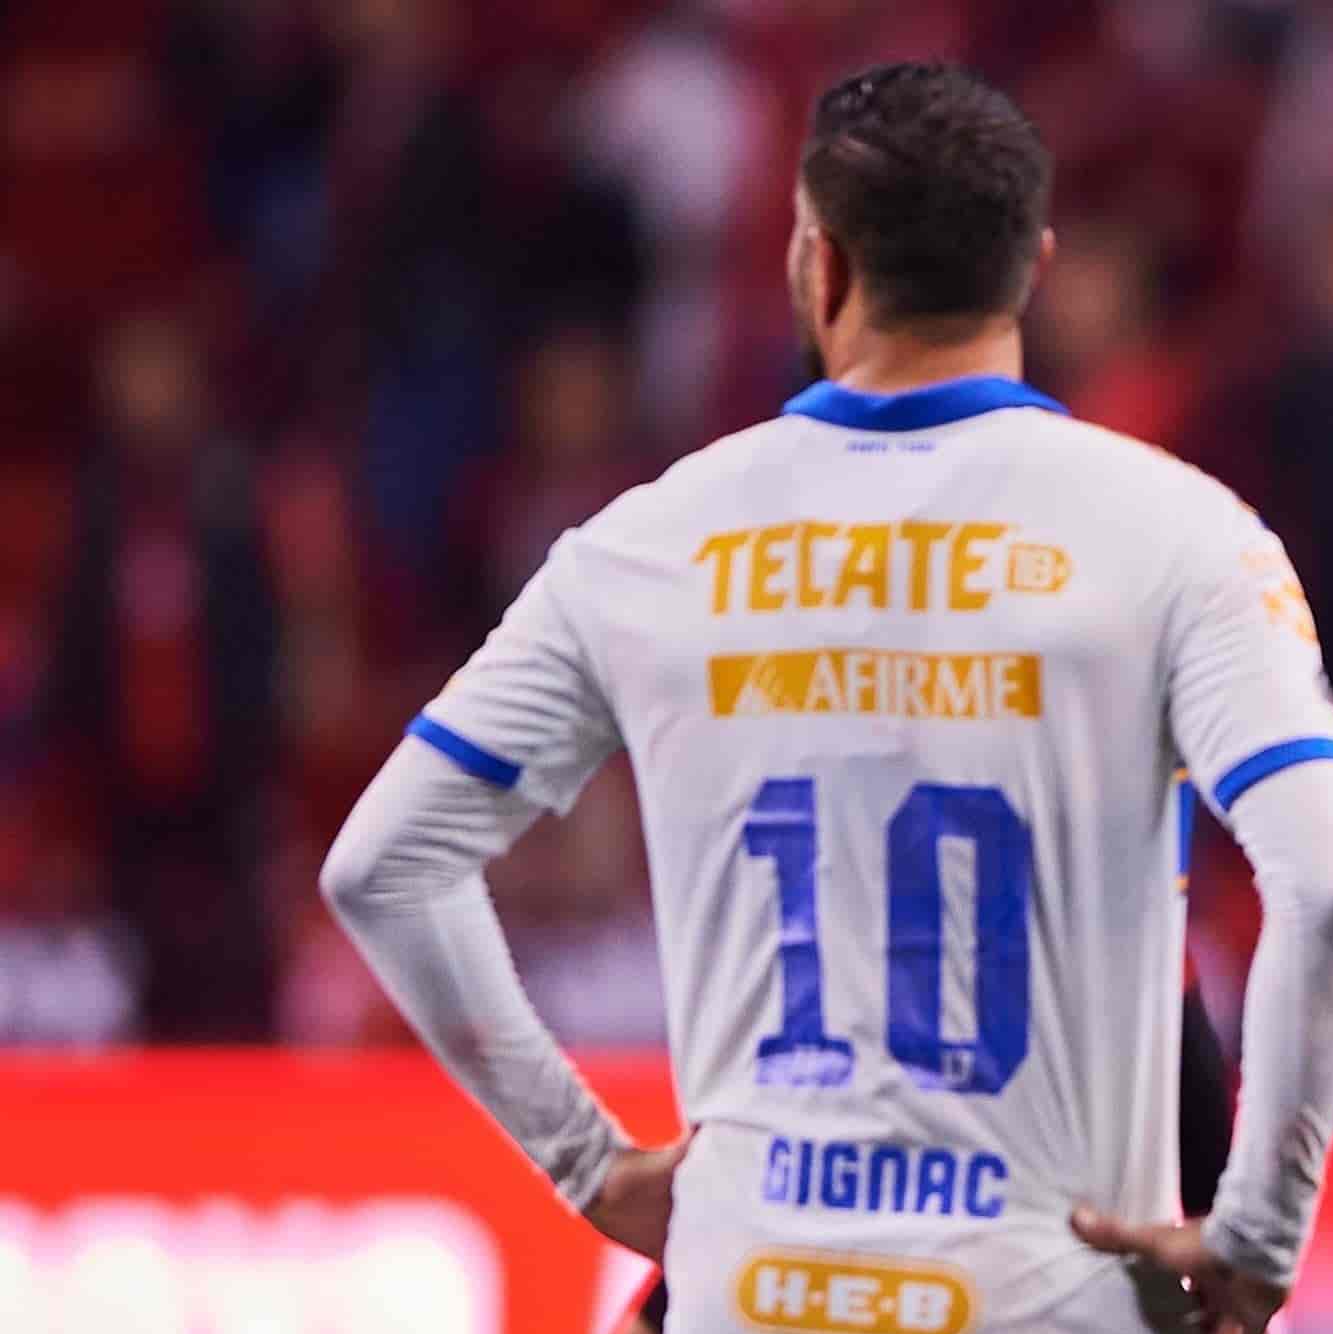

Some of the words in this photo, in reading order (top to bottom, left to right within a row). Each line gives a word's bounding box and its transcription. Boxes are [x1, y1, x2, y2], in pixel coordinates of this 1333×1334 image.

[693, 520, 1005, 615] TECATE
[805, 652, 1021, 718] AFIRME
[743, 776, 1032, 1095] 10
[760, 1139, 1009, 1219] GIGNAC
